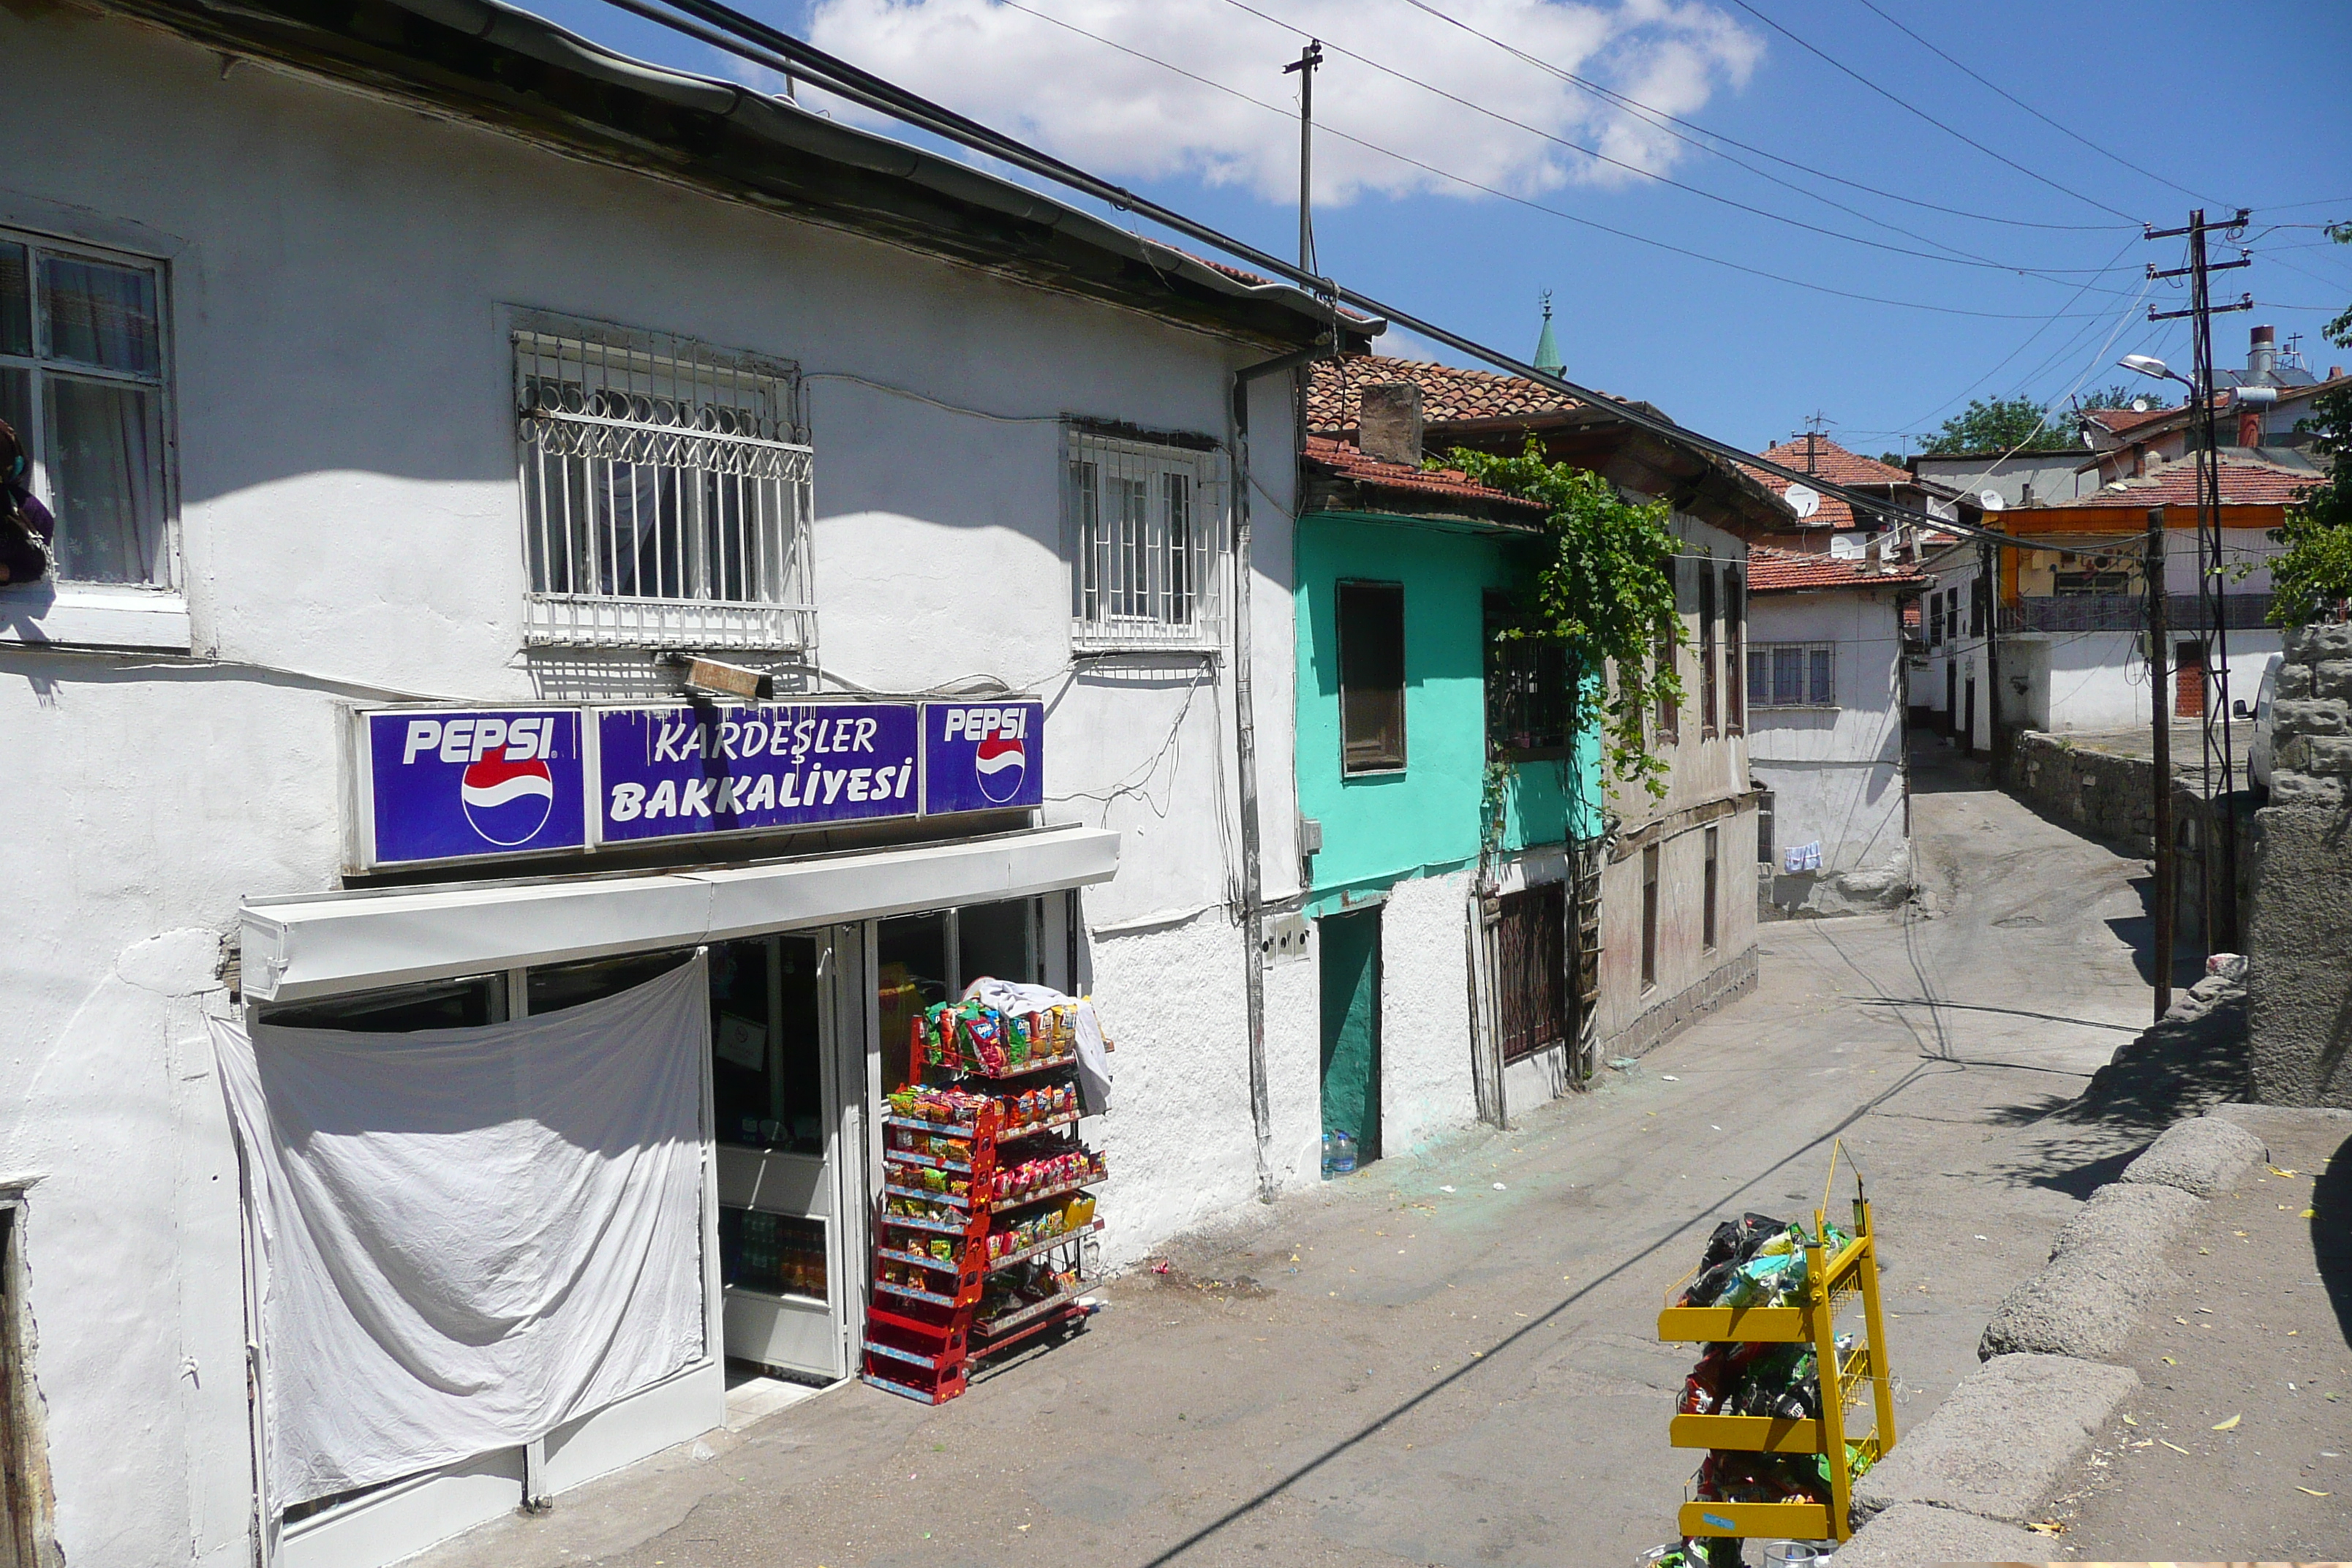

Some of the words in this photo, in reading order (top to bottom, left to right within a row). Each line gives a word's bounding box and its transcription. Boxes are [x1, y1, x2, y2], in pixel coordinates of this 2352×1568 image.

[402, 717, 554, 764] PEPSI
[655, 718, 878, 764] KARDEŞLER
[944, 708, 1028, 742] PEPSI
[610, 757, 913, 822] BAKKALİYESİ
